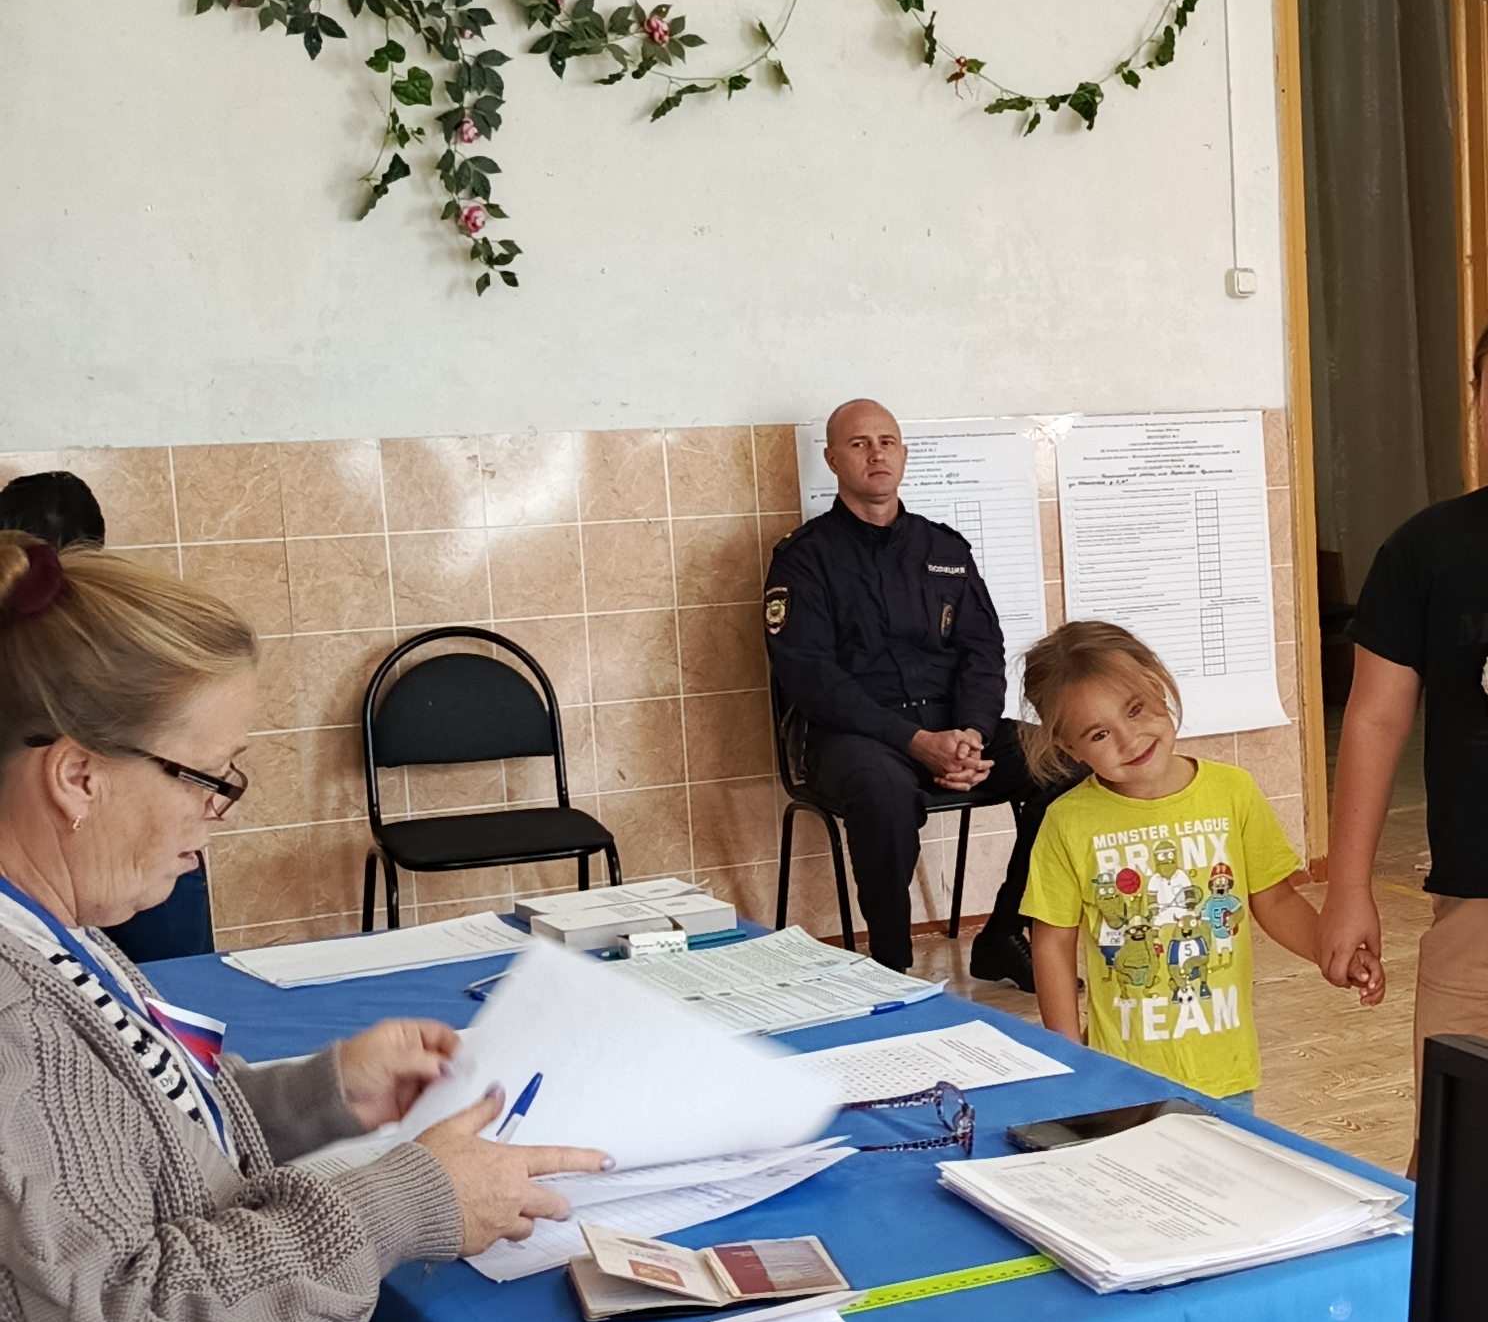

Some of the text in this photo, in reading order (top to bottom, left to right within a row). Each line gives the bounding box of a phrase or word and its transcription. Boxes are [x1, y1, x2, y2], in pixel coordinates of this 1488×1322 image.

[1093, 817, 1230, 849] MONSTER LEAGUE
[1096, 833, 1229, 879] BRNX
[1113, 985, 1240, 1041] TEAM
